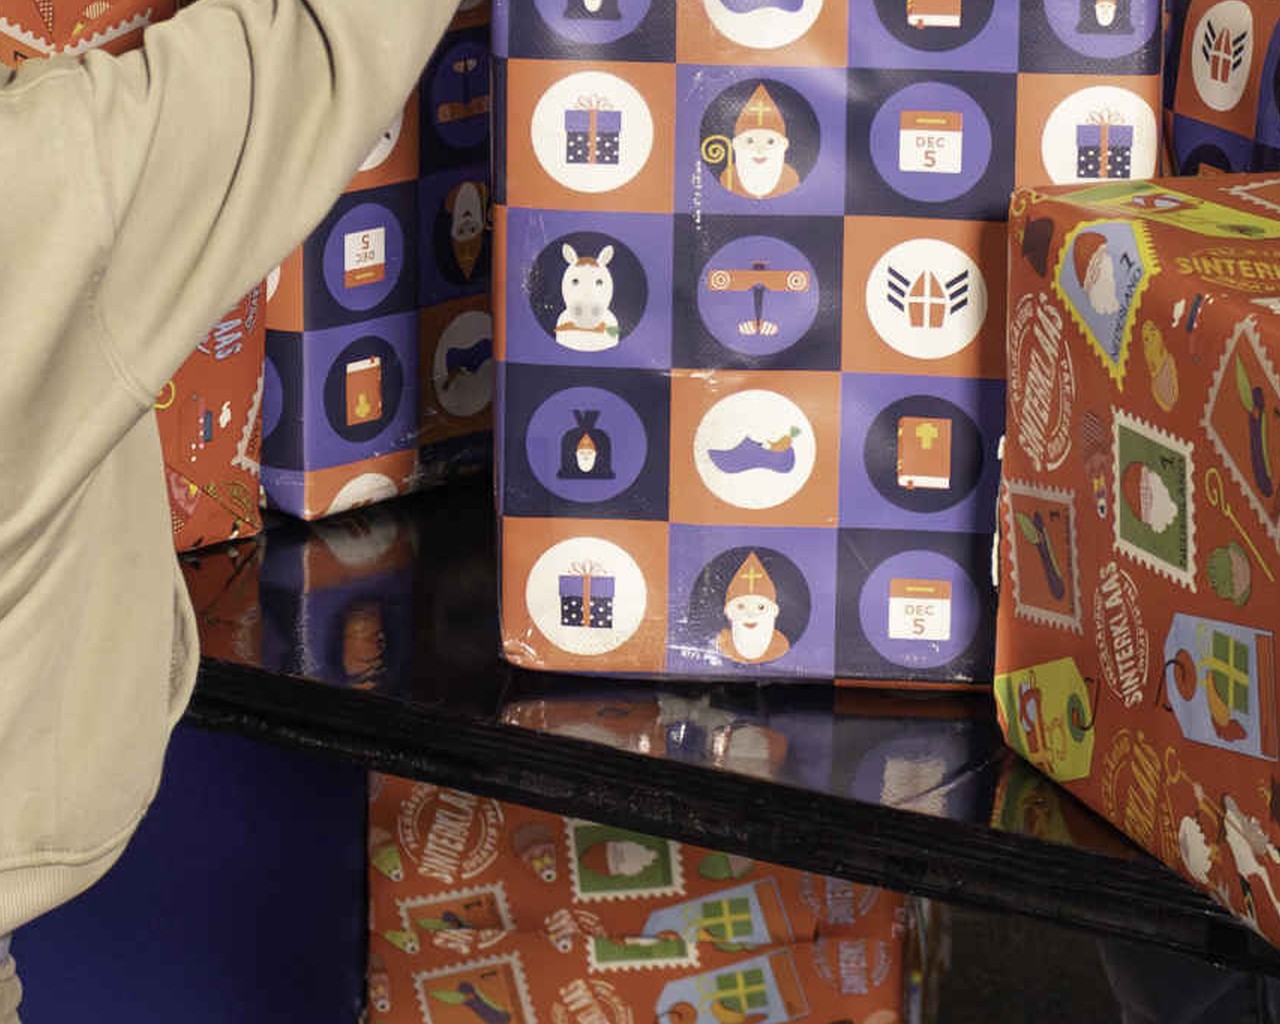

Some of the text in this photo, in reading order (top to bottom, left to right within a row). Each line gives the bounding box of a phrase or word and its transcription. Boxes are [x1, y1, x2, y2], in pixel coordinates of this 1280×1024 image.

[915, 136, 947, 151] DEC
[924, 151, 937, 169] 5
[362, 233, 372, 251] 5
[904, 603, 937, 619] DEC
[913, 619, 927, 638] 5
[1099, 560, 1144, 710] SINTERKLAAS
